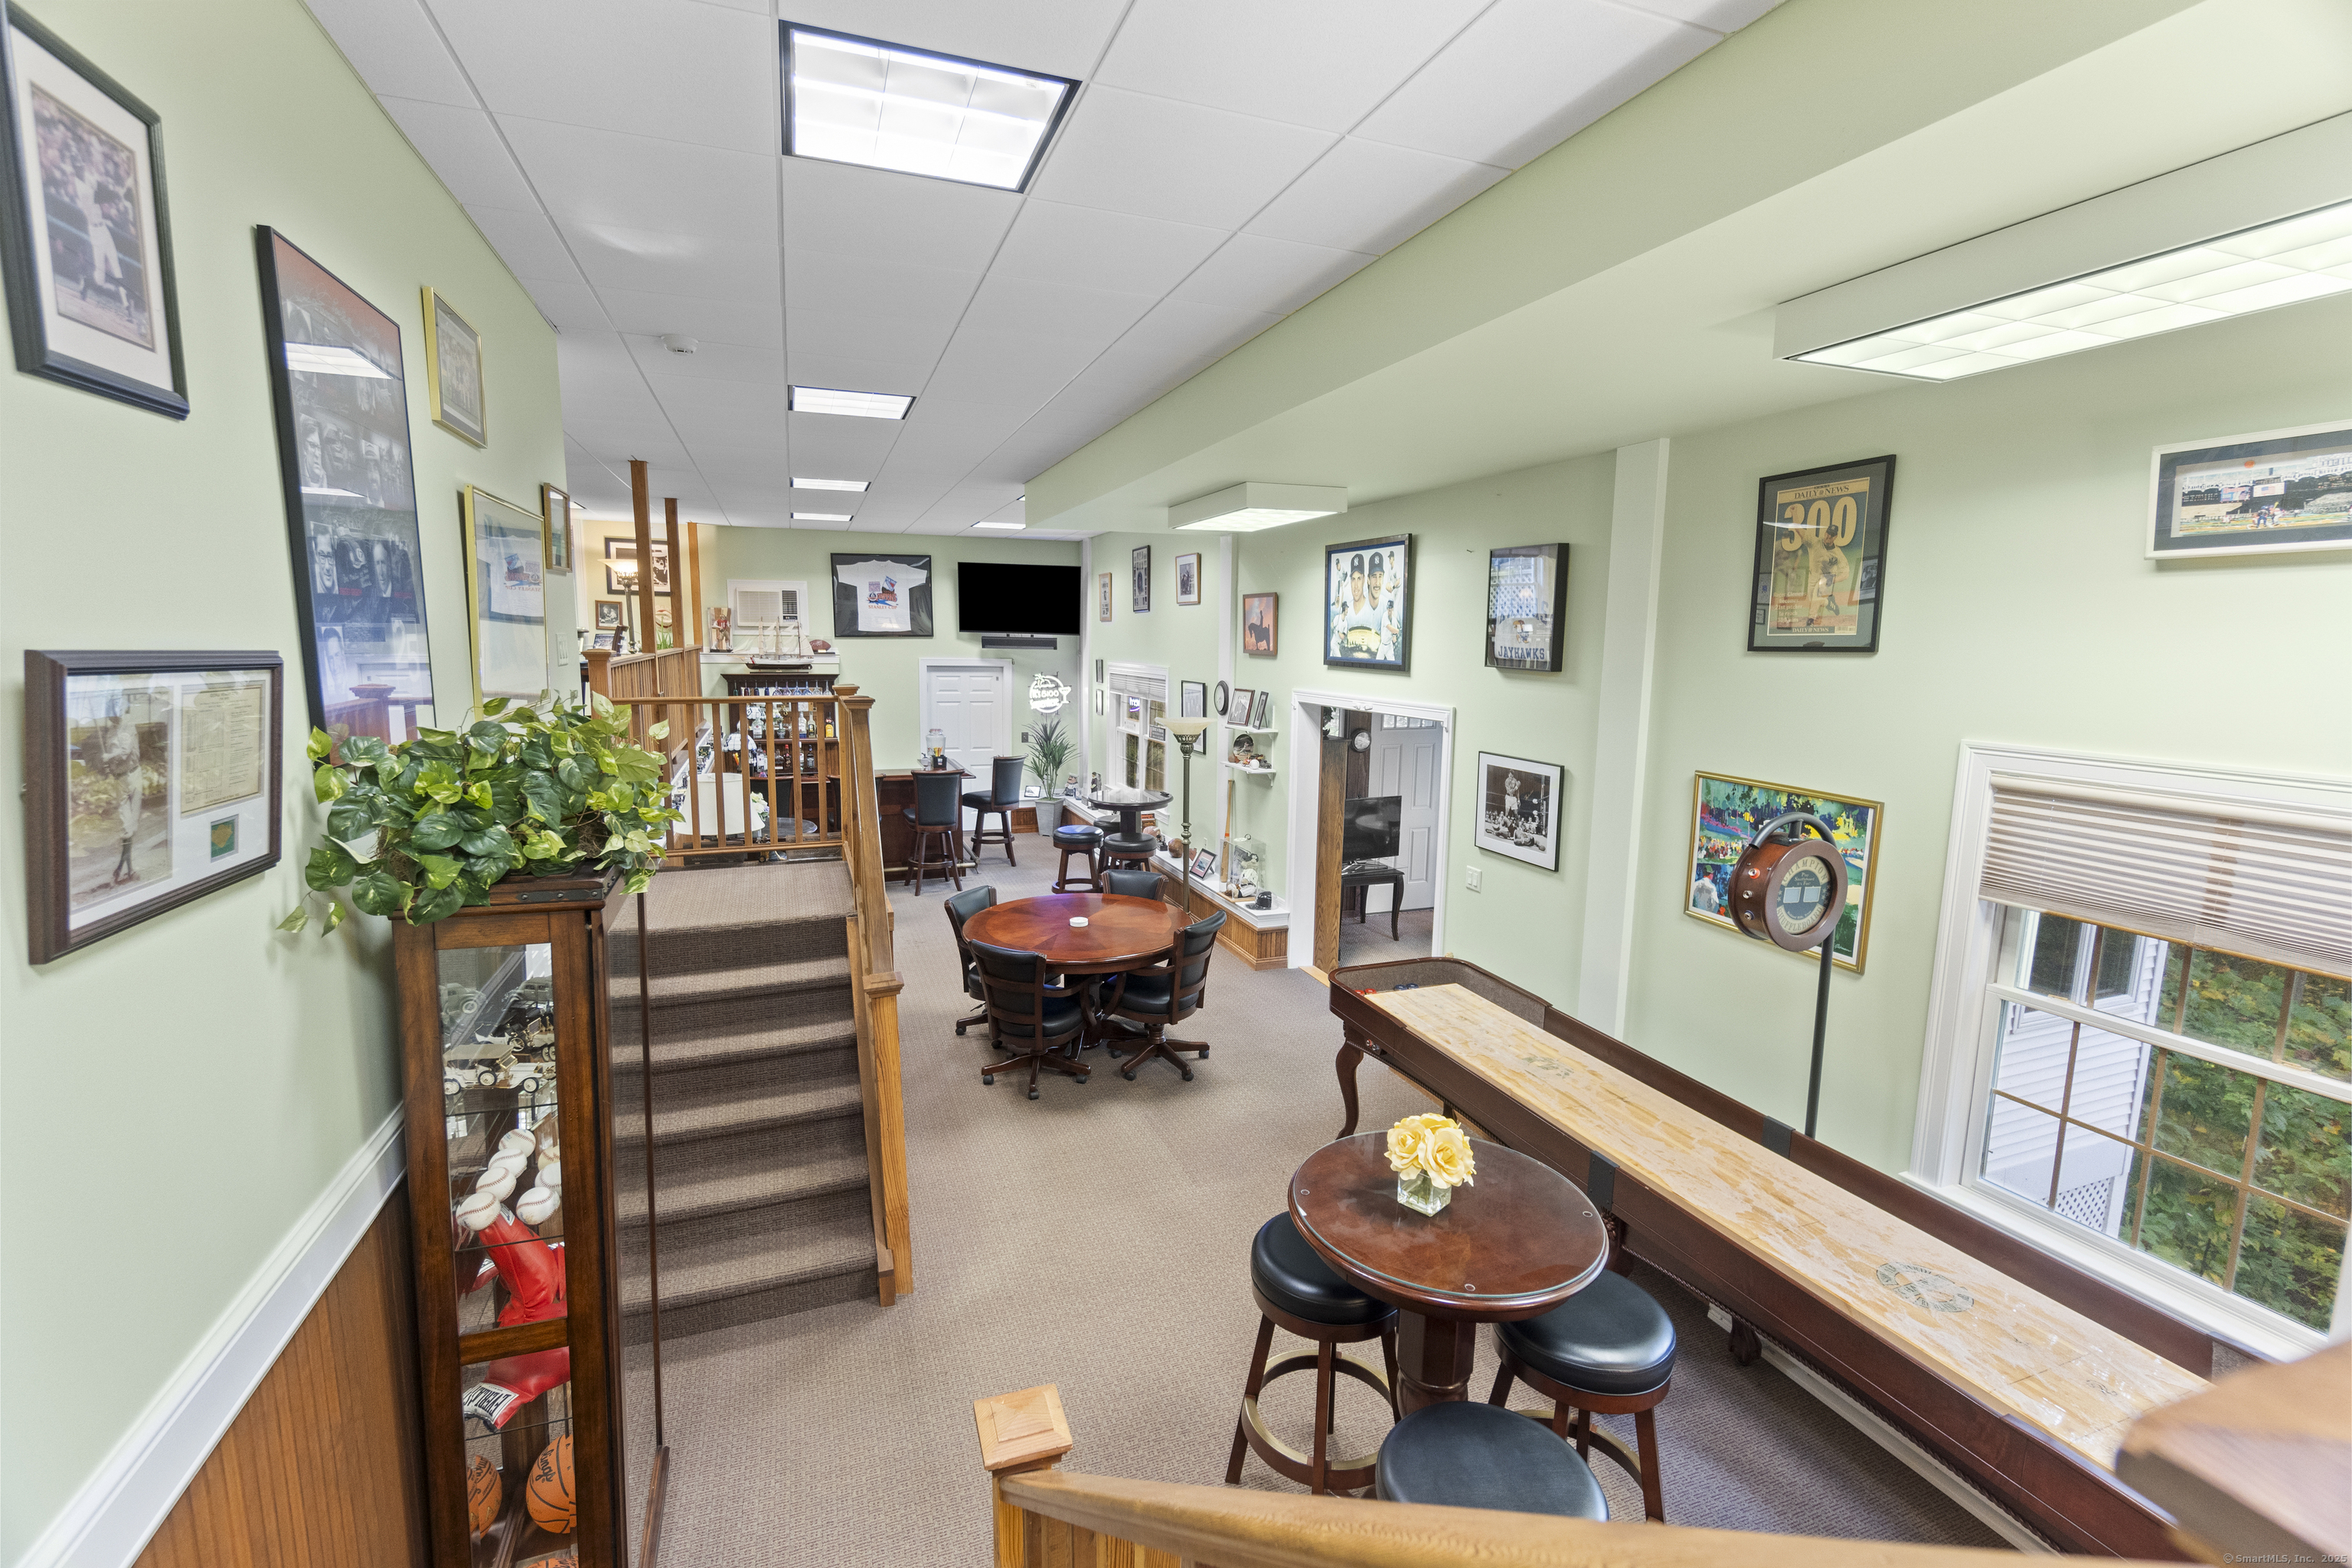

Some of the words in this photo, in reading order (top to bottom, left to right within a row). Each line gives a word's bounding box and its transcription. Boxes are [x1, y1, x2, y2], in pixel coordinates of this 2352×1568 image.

[1795, 490, 1818, 499] DAILY
[1825, 485, 1850, 496] NEWS
[1781, 496, 1857, 551] 300
[1498, 646, 1545, 660] JAYHAWKS
[1783, 859, 1828, 882] CHAMPION
[1777, 906, 1822, 931] SHUFFLEBOARD
